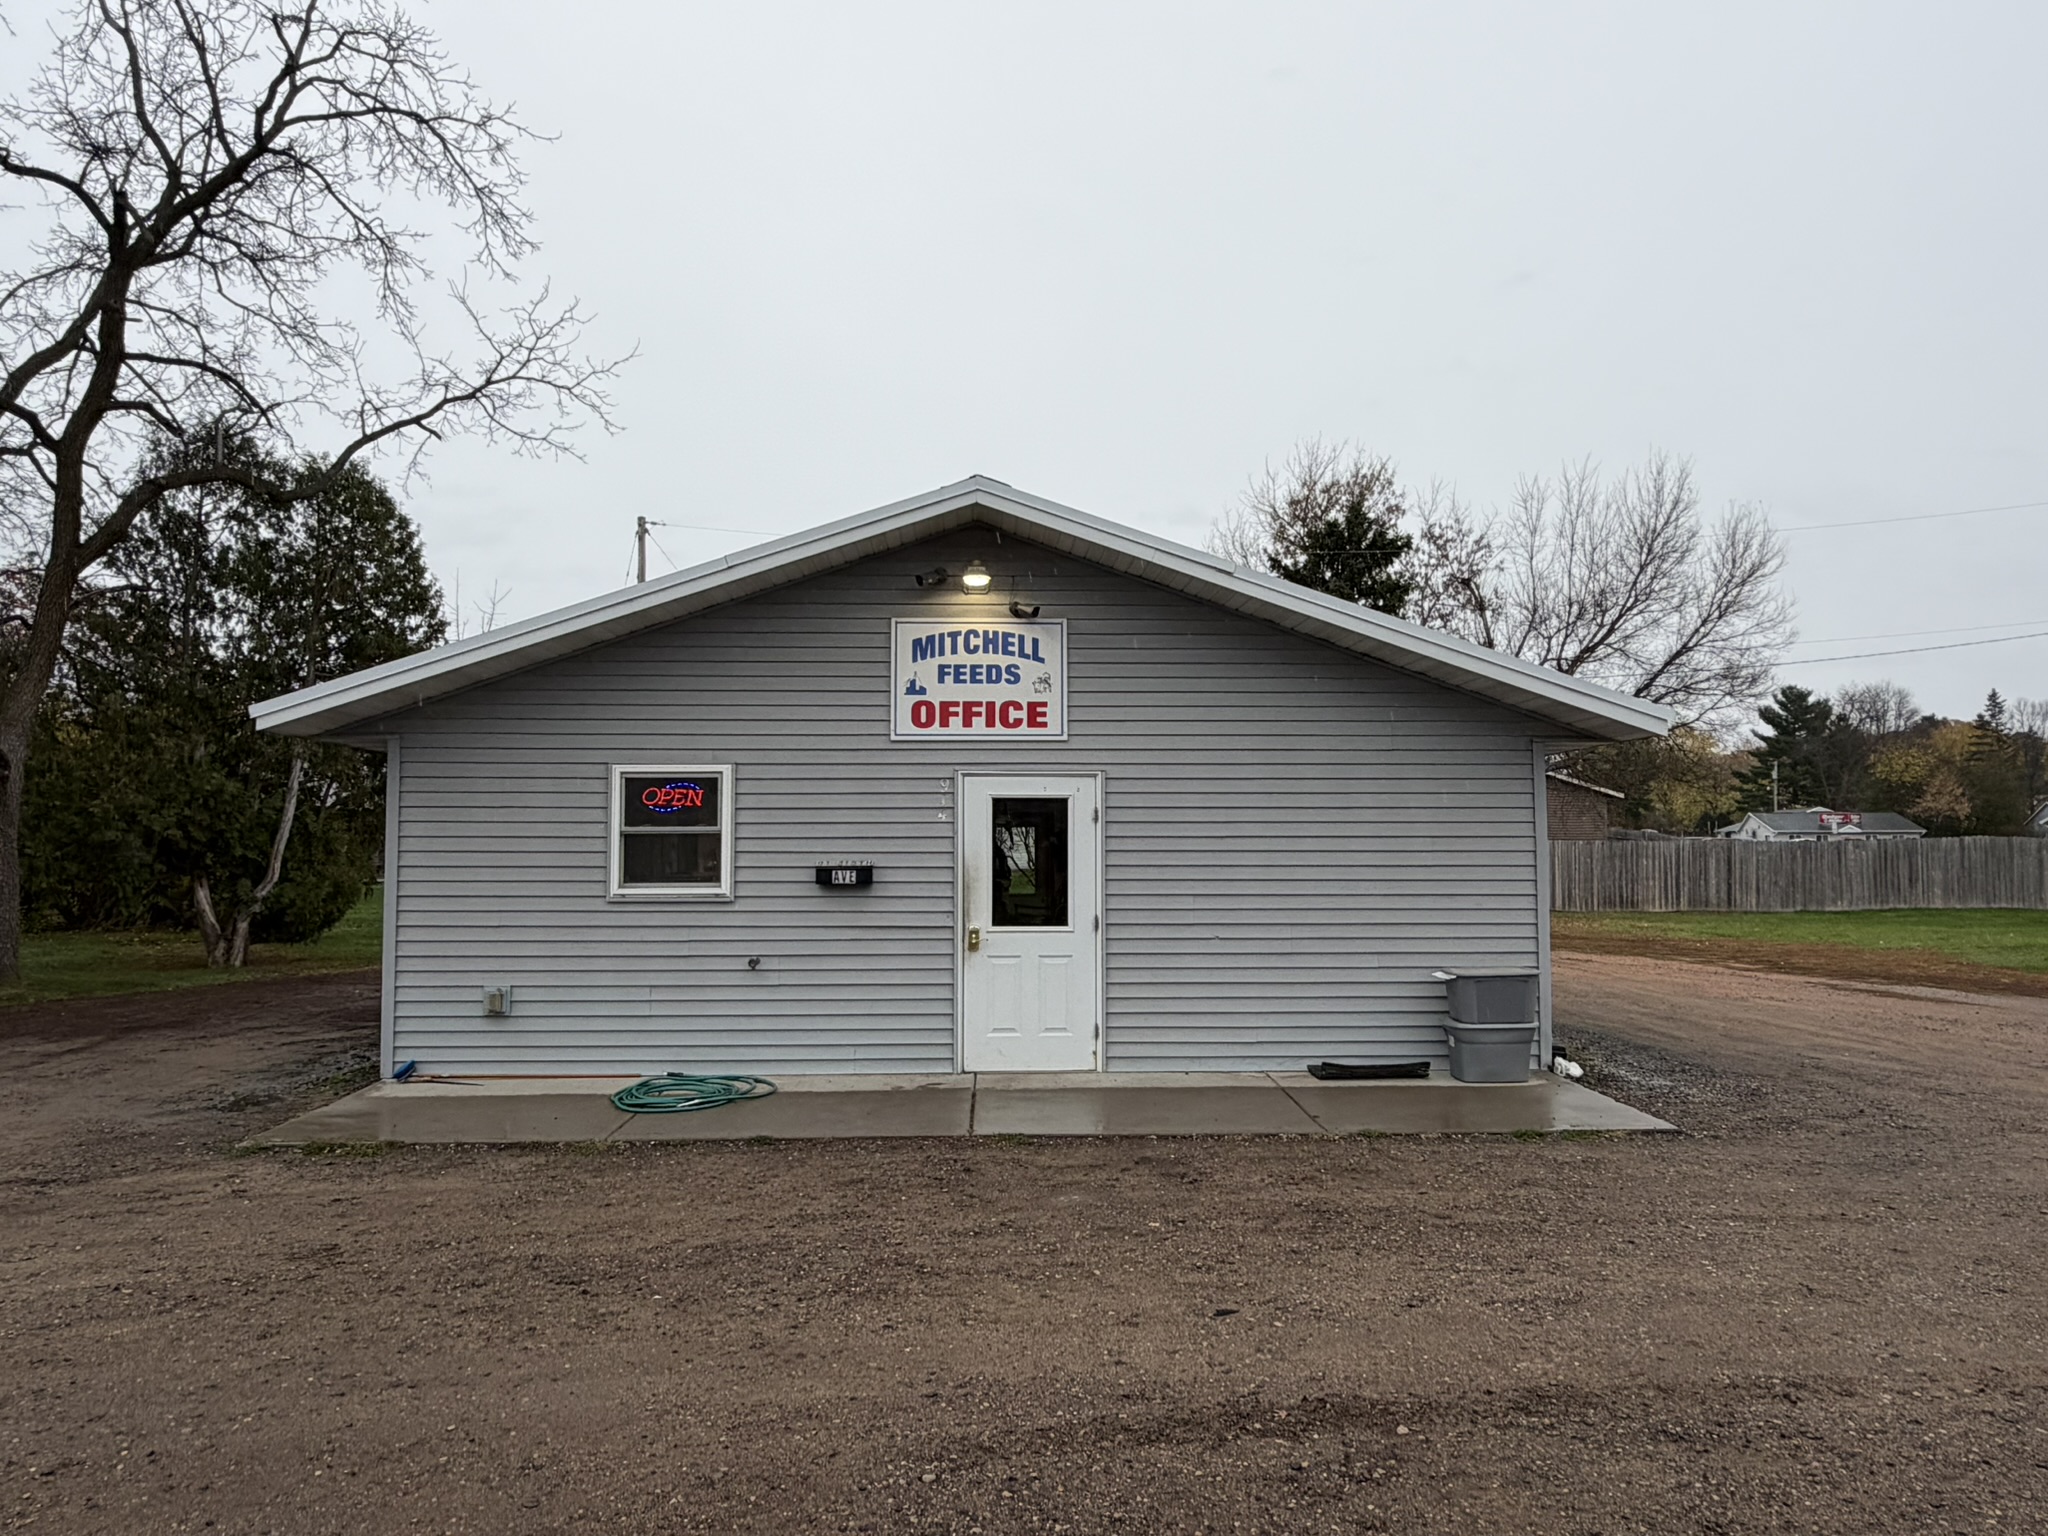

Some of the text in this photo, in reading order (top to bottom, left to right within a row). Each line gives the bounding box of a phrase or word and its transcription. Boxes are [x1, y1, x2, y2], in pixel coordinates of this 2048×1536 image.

[911, 629, 1046, 665] MITCHELL
[937, 663, 1022, 685] FEEDS
[911, 699, 1049, 729] OFFICE
[642, 787, 705, 807] OPEN
[833, 870, 855, 883] AVE
